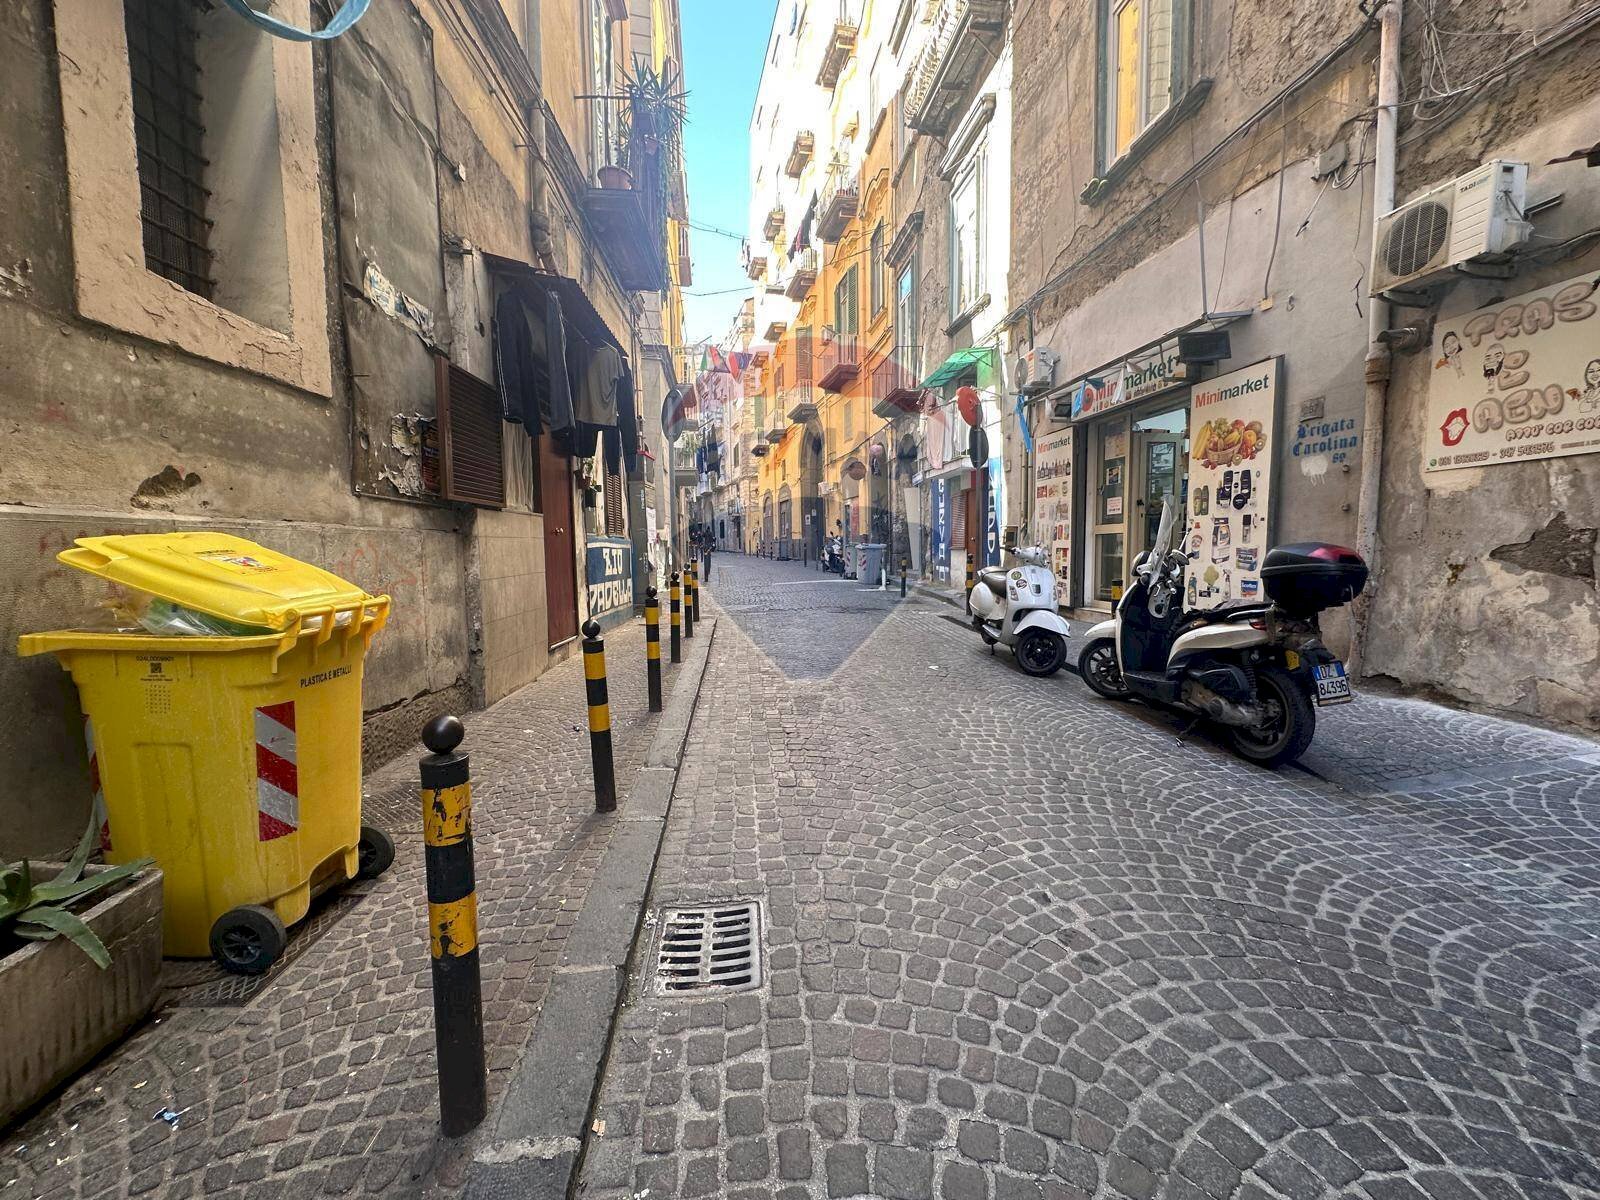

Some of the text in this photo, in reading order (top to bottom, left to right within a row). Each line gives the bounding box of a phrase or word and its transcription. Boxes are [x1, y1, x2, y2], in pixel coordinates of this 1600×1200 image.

[1195, 374, 1269, 409] Minimarket
[1038, 436, 1071, 454] Minimarket
[1292, 436, 1358, 457] Carolina
[300, 673, 328, 688] PLASTICA
